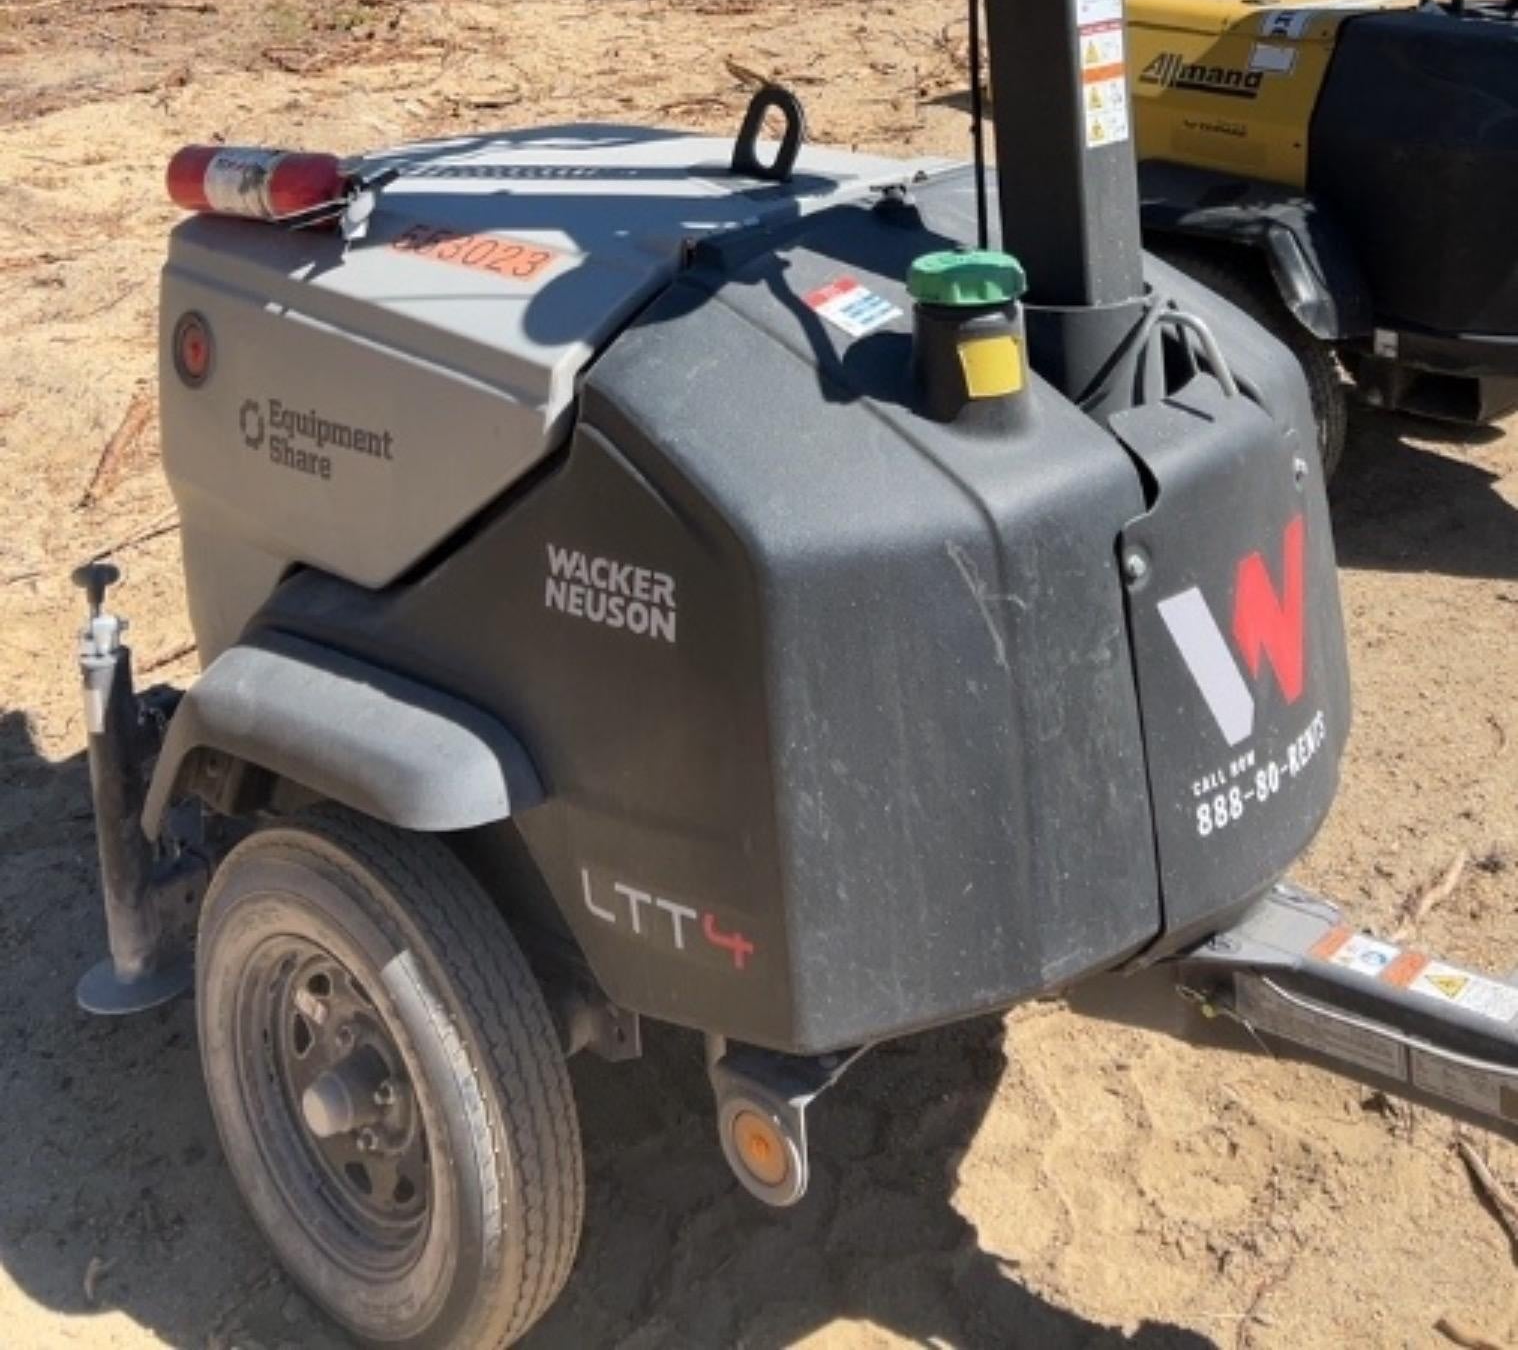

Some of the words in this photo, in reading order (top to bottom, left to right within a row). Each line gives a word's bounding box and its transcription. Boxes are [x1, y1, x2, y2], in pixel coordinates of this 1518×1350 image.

[1140, 52, 1264, 90] Allmand
[268, 398, 394, 461] Equipment
[269, 434, 332, 481] Share
[546, 541, 677, 610] WACKER
[545, 577, 677, 644] NEUSON
[1191, 768, 1226, 796] CALL
[1195, 709, 1326, 837] 888-80-RENTS
[580, 867, 754, 971] LTT4
